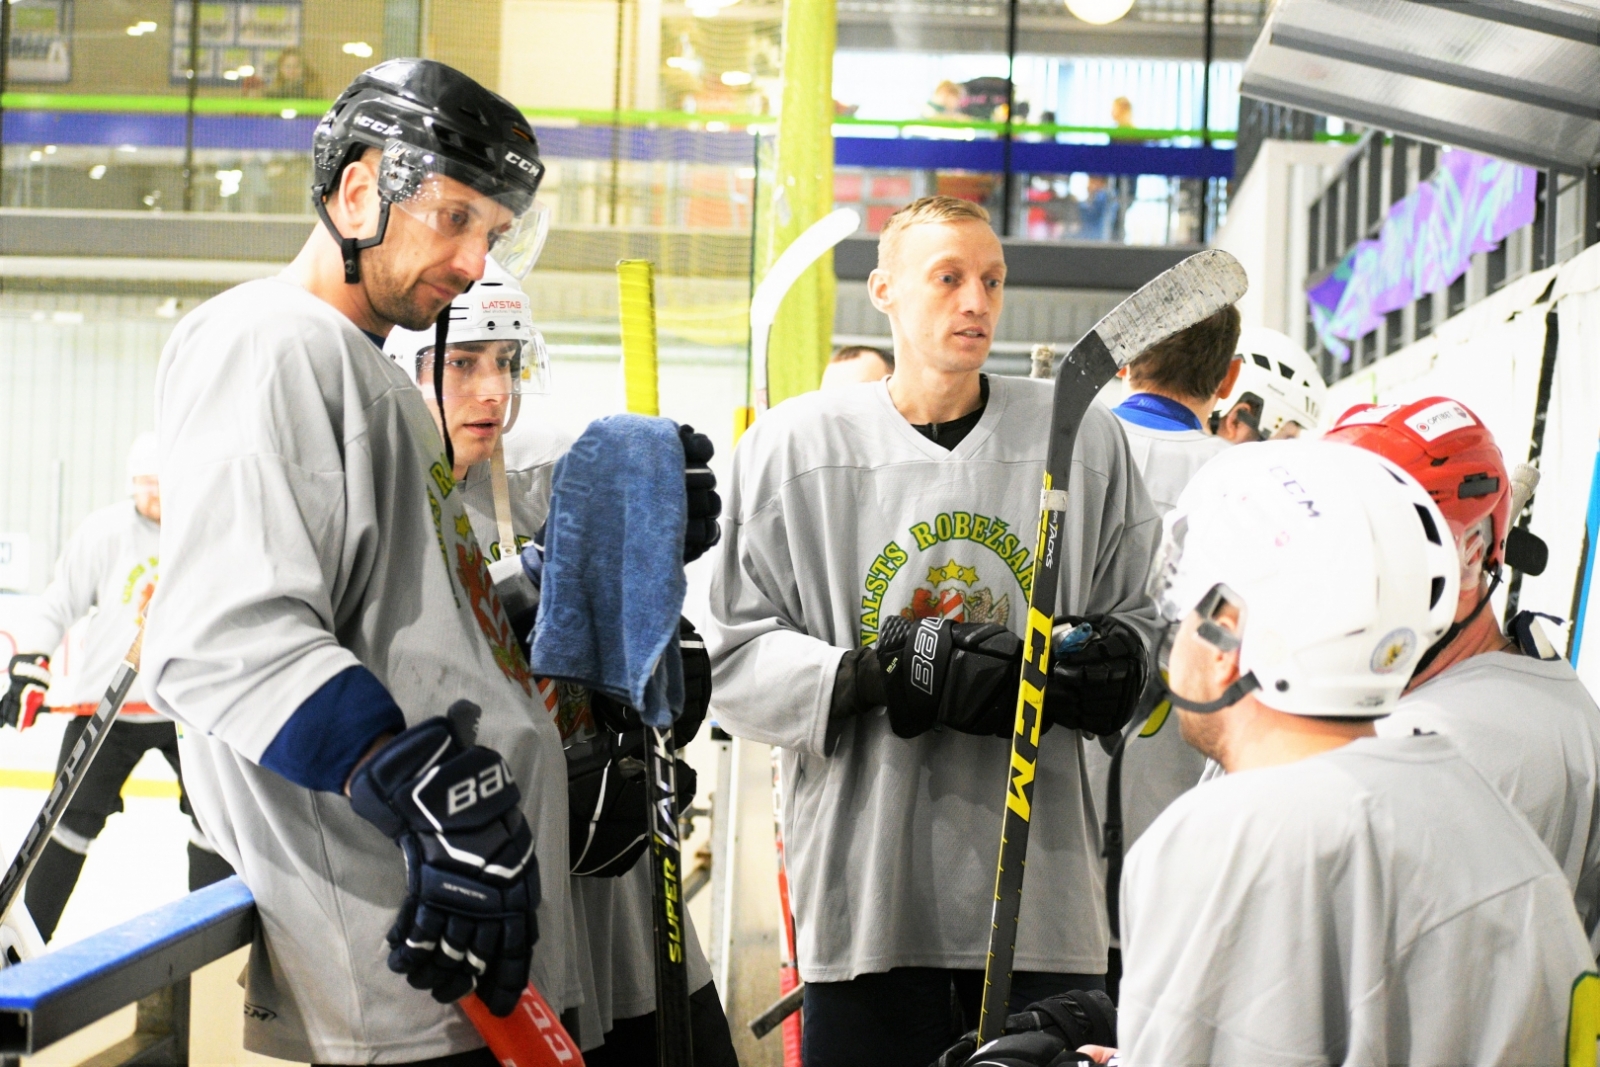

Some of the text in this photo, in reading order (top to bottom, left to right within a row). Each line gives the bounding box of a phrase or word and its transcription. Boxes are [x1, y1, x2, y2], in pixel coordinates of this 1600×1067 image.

[504, 151, 540, 177] CCM
[482, 300, 521, 309] LATSTAB
[1427, 411, 1452, 425] OPTIBET
[1045, 522, 1059, 569] TACKS
[860, 511, 1034, 646] VALSTS ROBEŽSAR
[1007, 607, 1054, 822] CCM
[652, 726, 682, 964] SUPER TACK
